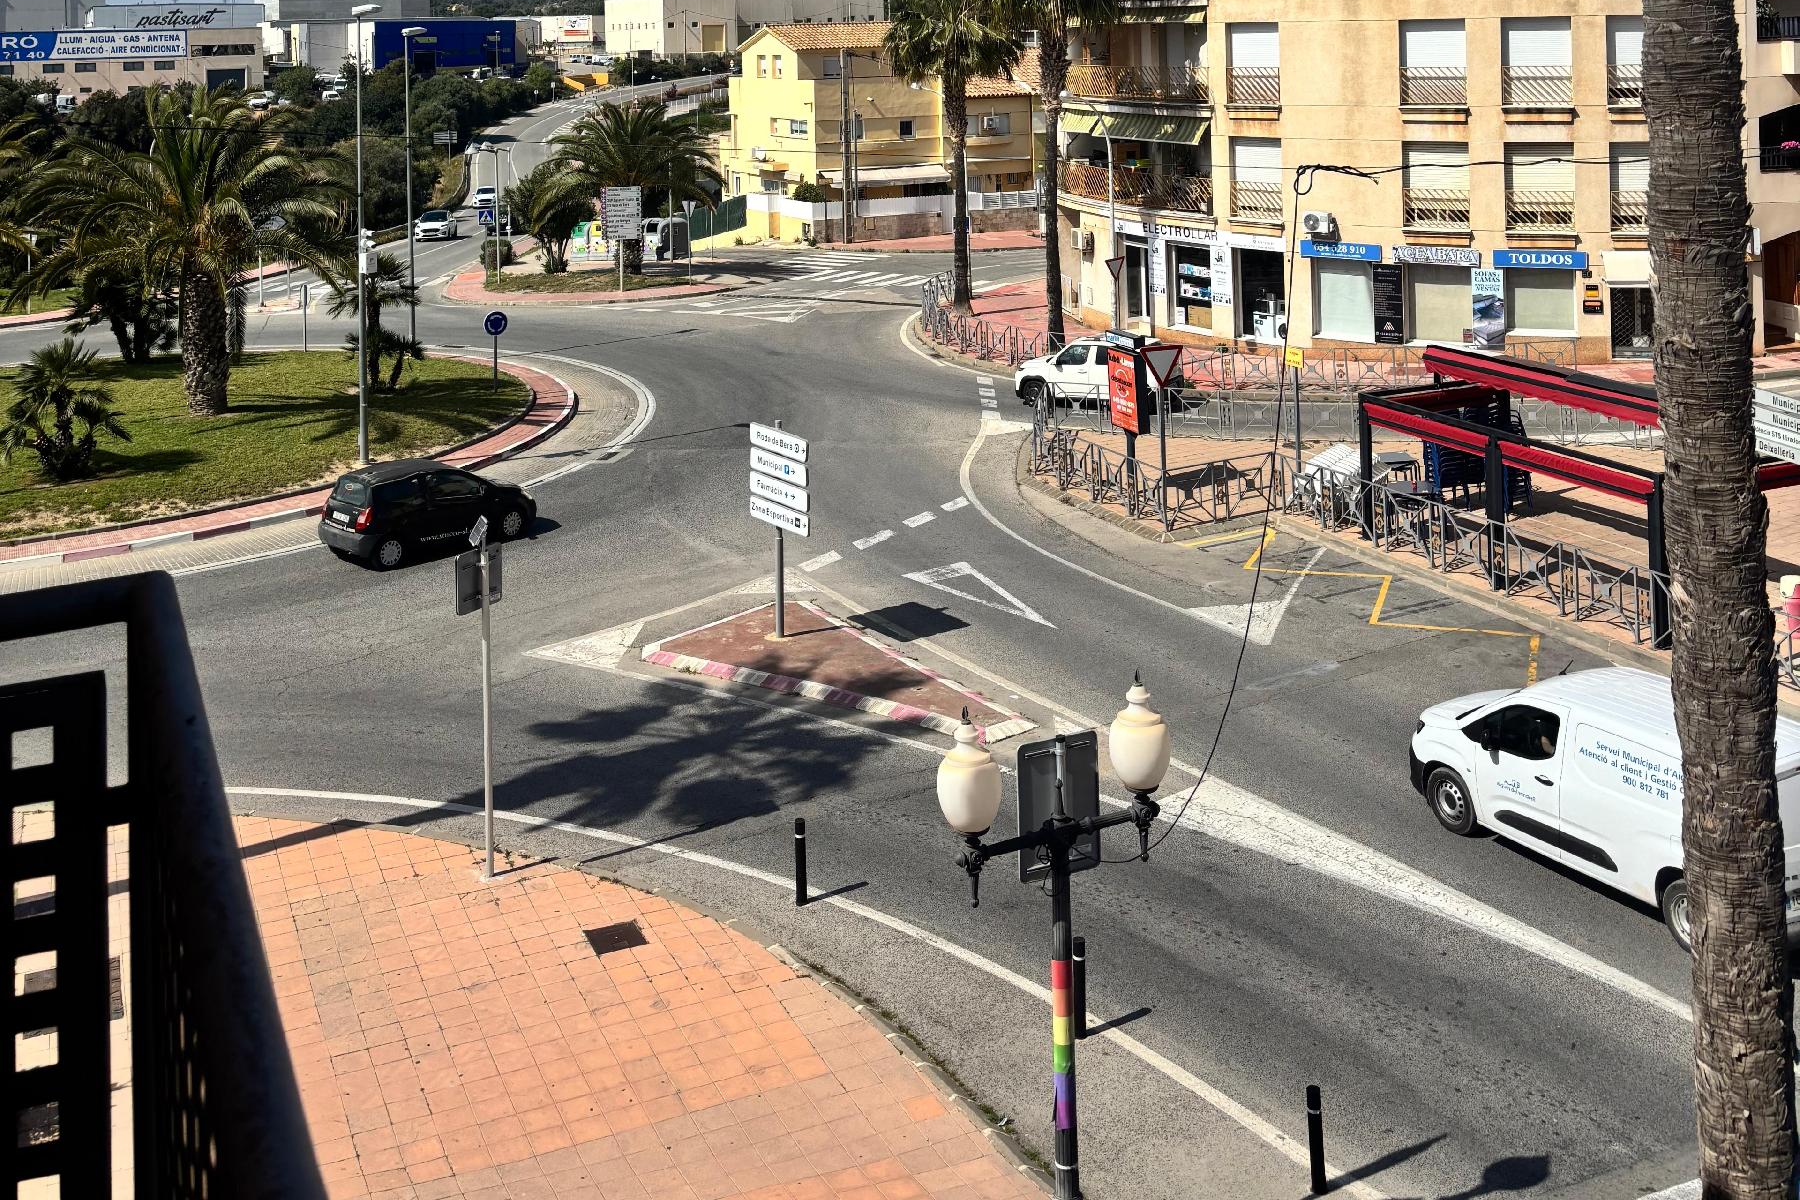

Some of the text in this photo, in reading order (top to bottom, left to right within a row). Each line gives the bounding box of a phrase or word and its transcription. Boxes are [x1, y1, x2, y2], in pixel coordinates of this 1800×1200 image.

[136, 9, 227, 28] pastisart
[59, 34, 181, 44] LLUM AIGUA GAS ANTENA
[26, 50, 45, 59] 40
[56, 45, 181, 55] CALEFACCIÓ AIRE CONDICIONAT
[1142, 222, 1218, 241] ELECTROLLAR
[1349, 245, 1366, 255] 910
[1508, 253, 1573, 265] TOLDOS
[1759, 440, 1795, 460] Deixalleria
[757, 455, 783, 471] Municipal
[751, 501, 794, 526] Zona Esportiva
[1596, 740, 1620, 757] Servei
[1622, 750, 1661, 773] Municipal
[1579, 746, 1608, 764] Atenció
[1610, 759, 1618, 768] al
[1620, 763, 1643, 778] client
[1650, 774, 1677, 791] Gestió
[1622, 775, 1637, 788] 900
[1639, 781, 1653, 794] 812
[1655, 787, 1669, 800] 781
